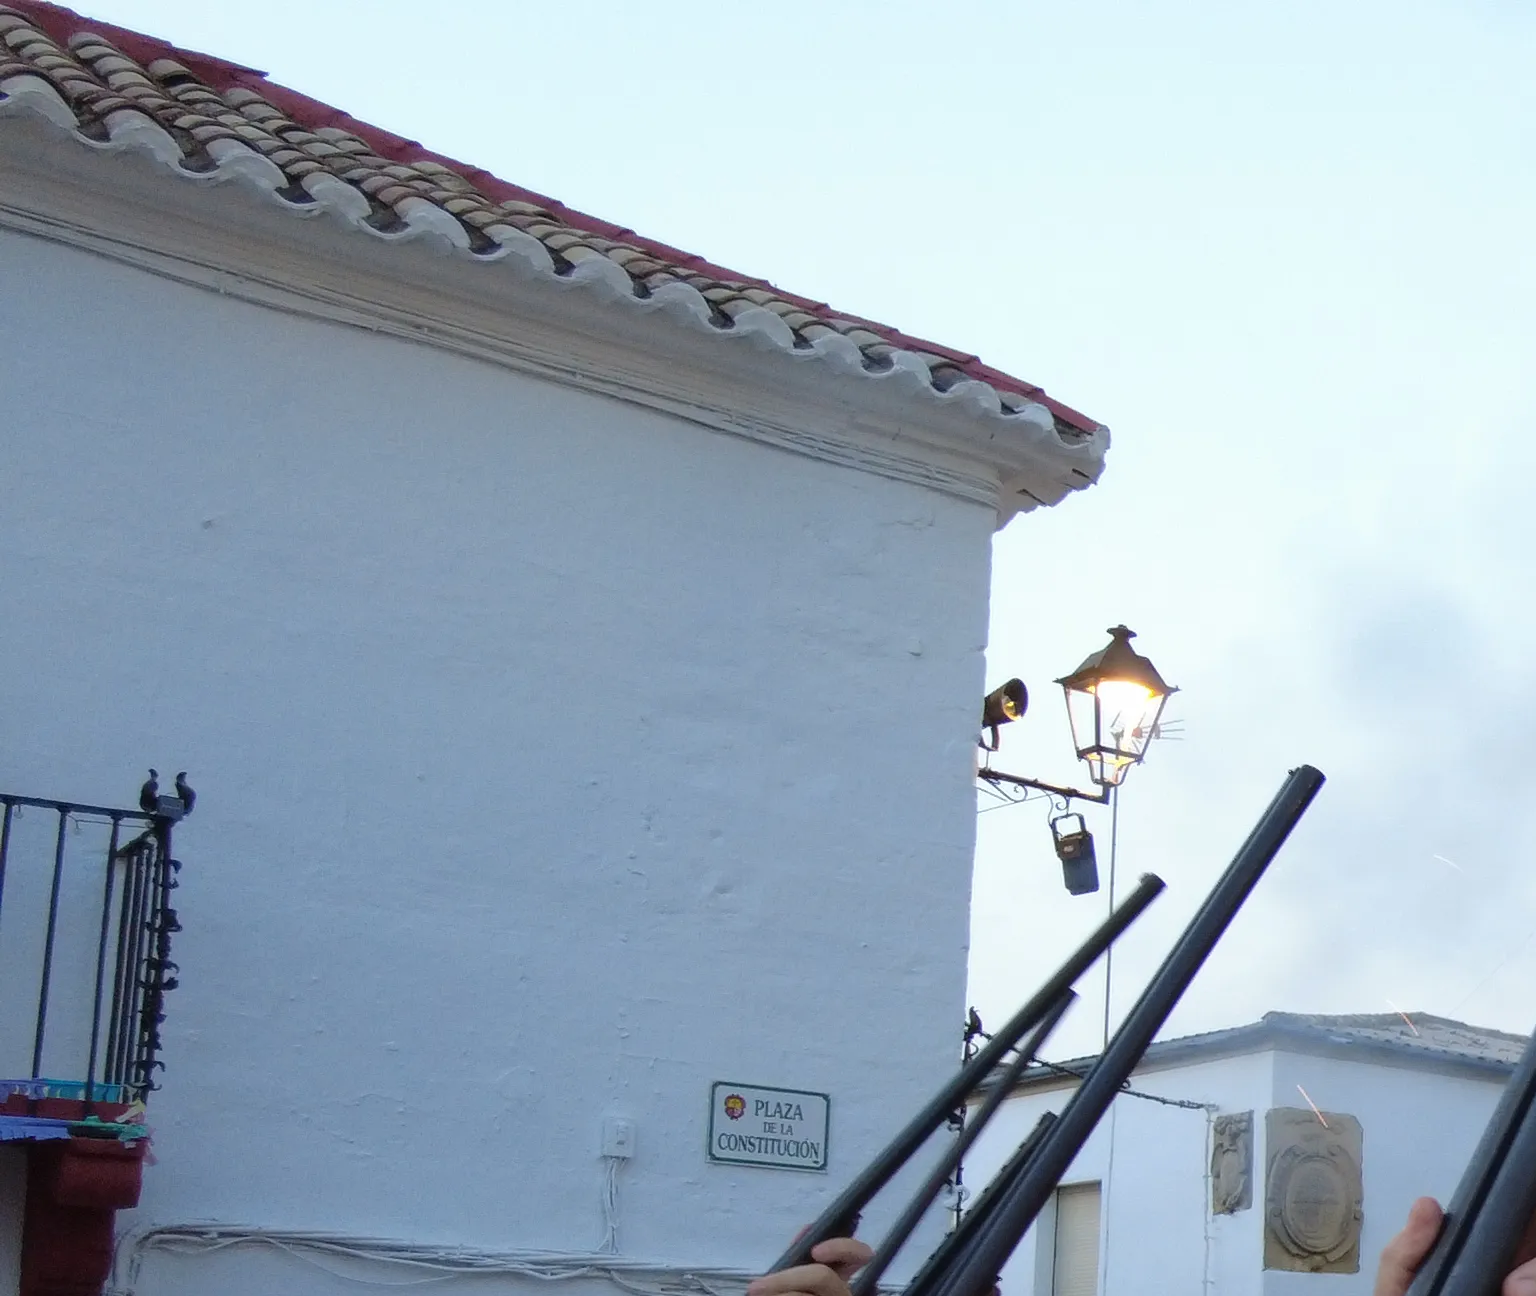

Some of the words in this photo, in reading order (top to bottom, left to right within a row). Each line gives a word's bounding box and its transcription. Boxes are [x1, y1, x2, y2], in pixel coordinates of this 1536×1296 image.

[755, 1099, 804, 1121] PLAZA
[763, 1121, 777, 1134] DE
[780, 1123, 793, 1135] LA
[718, 1133, 820, 1159] CONSTITUCIÓN
